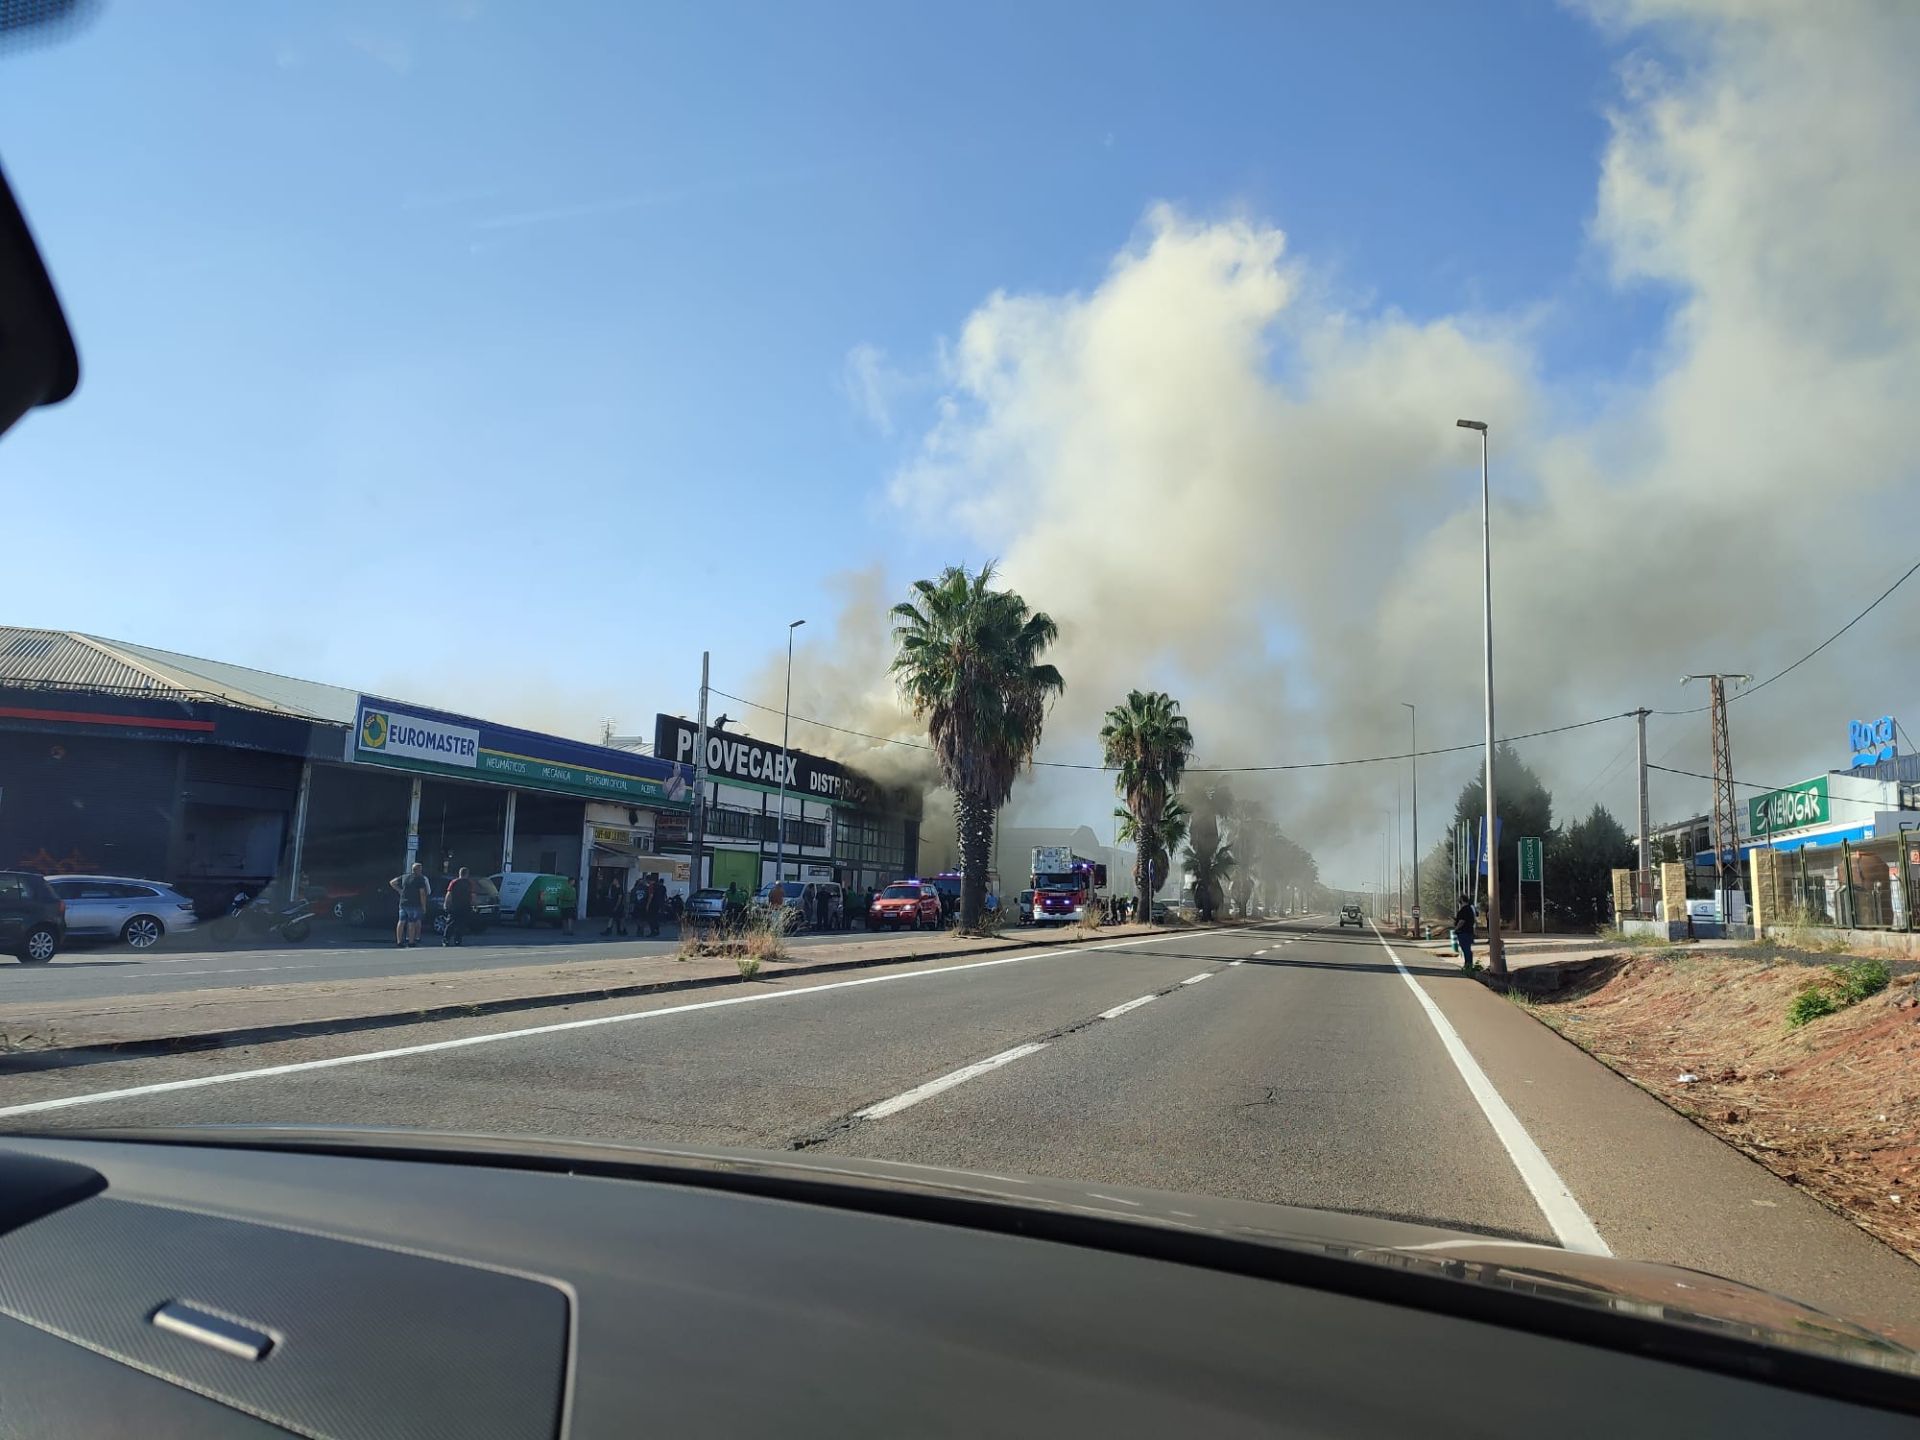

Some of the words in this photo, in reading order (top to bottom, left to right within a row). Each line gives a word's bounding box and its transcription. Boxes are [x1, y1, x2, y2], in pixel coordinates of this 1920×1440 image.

[389, 724, 476, 757] EUROMASTER
[1848, 716, 1893, 752] Roca
[486, 756, 527, 773] NEUMÁTICOS
[541, 767, 571, 782] MECÁNICA
